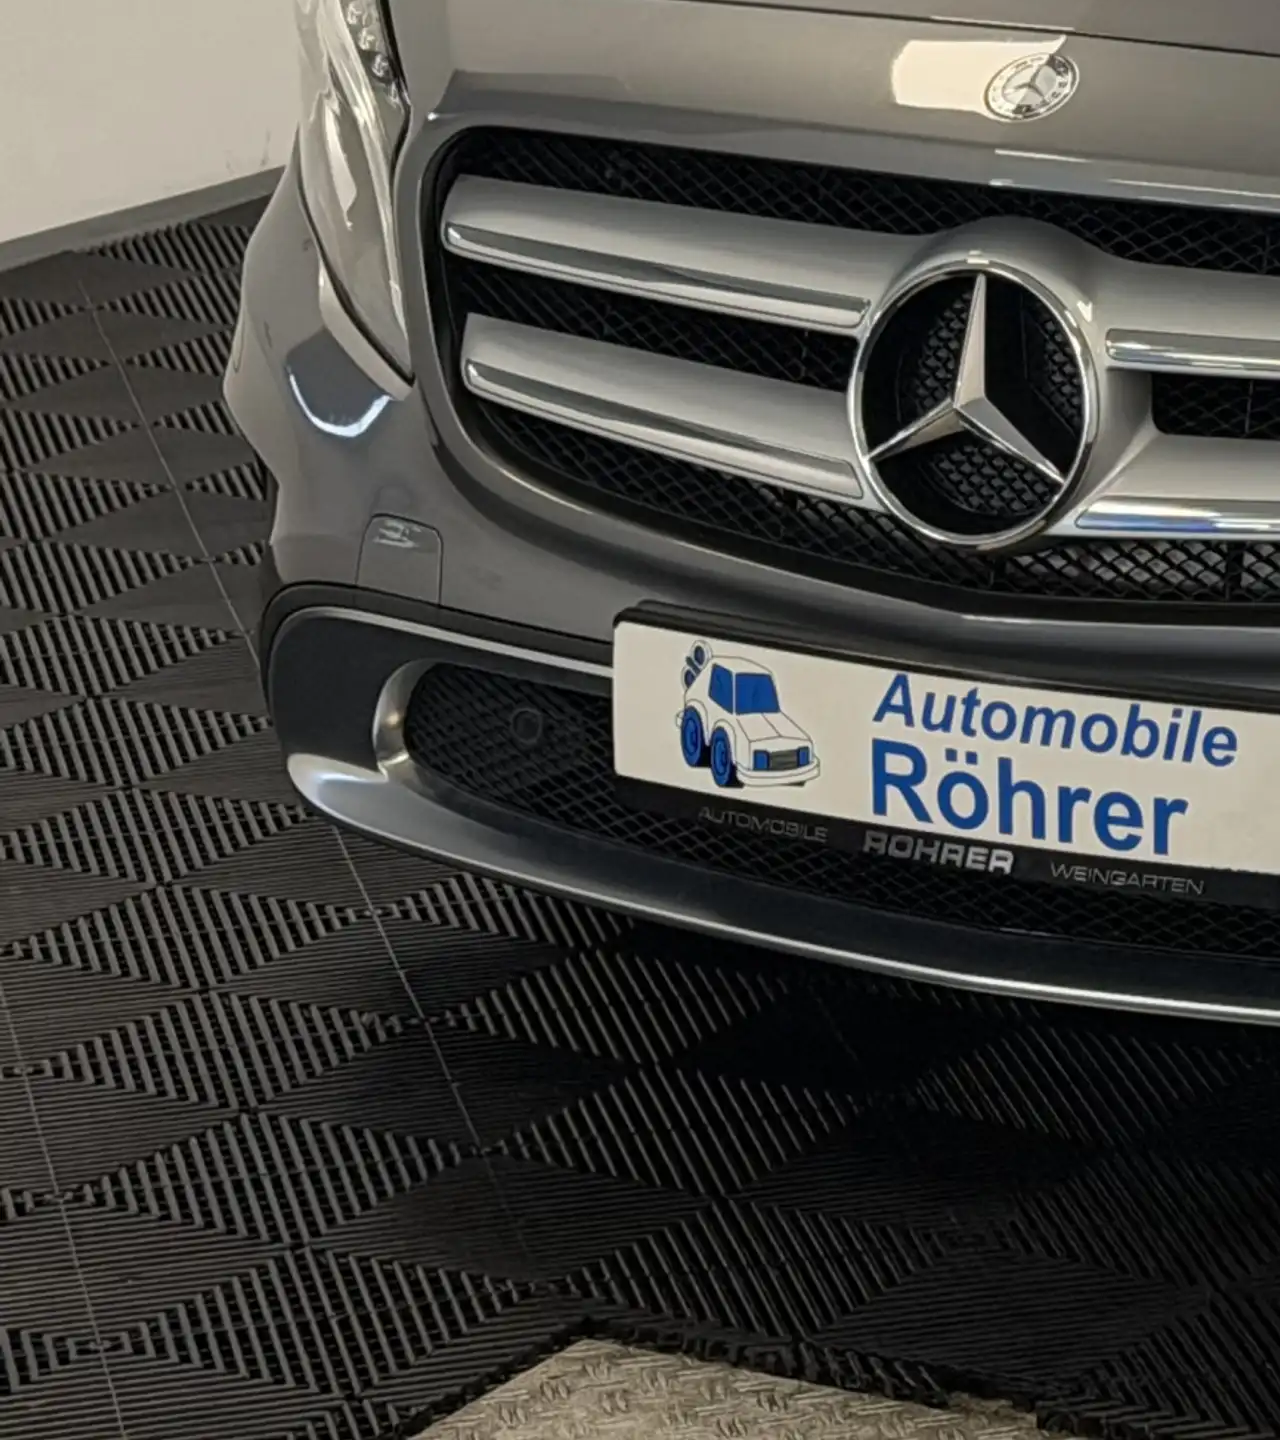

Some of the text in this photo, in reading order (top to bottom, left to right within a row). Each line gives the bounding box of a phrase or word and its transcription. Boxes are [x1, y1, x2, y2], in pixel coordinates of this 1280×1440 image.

[872, 673, 1238, 767] Automobile
[871, 737, 1189, 856] Röhrer
[698, 806, 828, 843] AUTOMOBILE
[1050, 861, 1205, 895] WEINGARTEN
